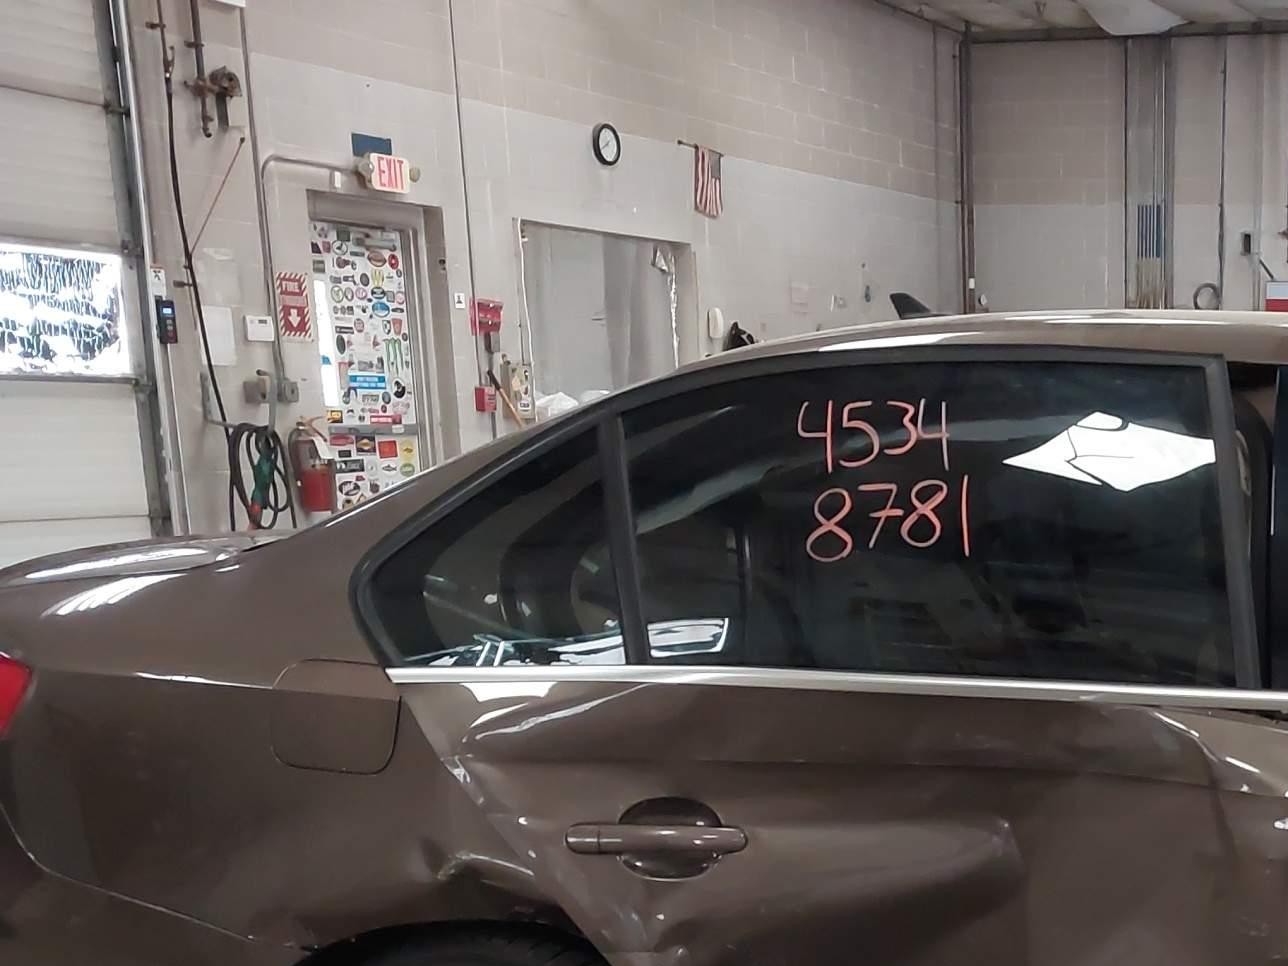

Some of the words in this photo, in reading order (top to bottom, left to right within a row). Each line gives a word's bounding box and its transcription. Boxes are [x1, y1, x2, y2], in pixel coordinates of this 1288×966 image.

[377, 156, 404, 190] EXIT
[796, 397, 950, 474] 4534
[805, 474, 970, 562] 8781
